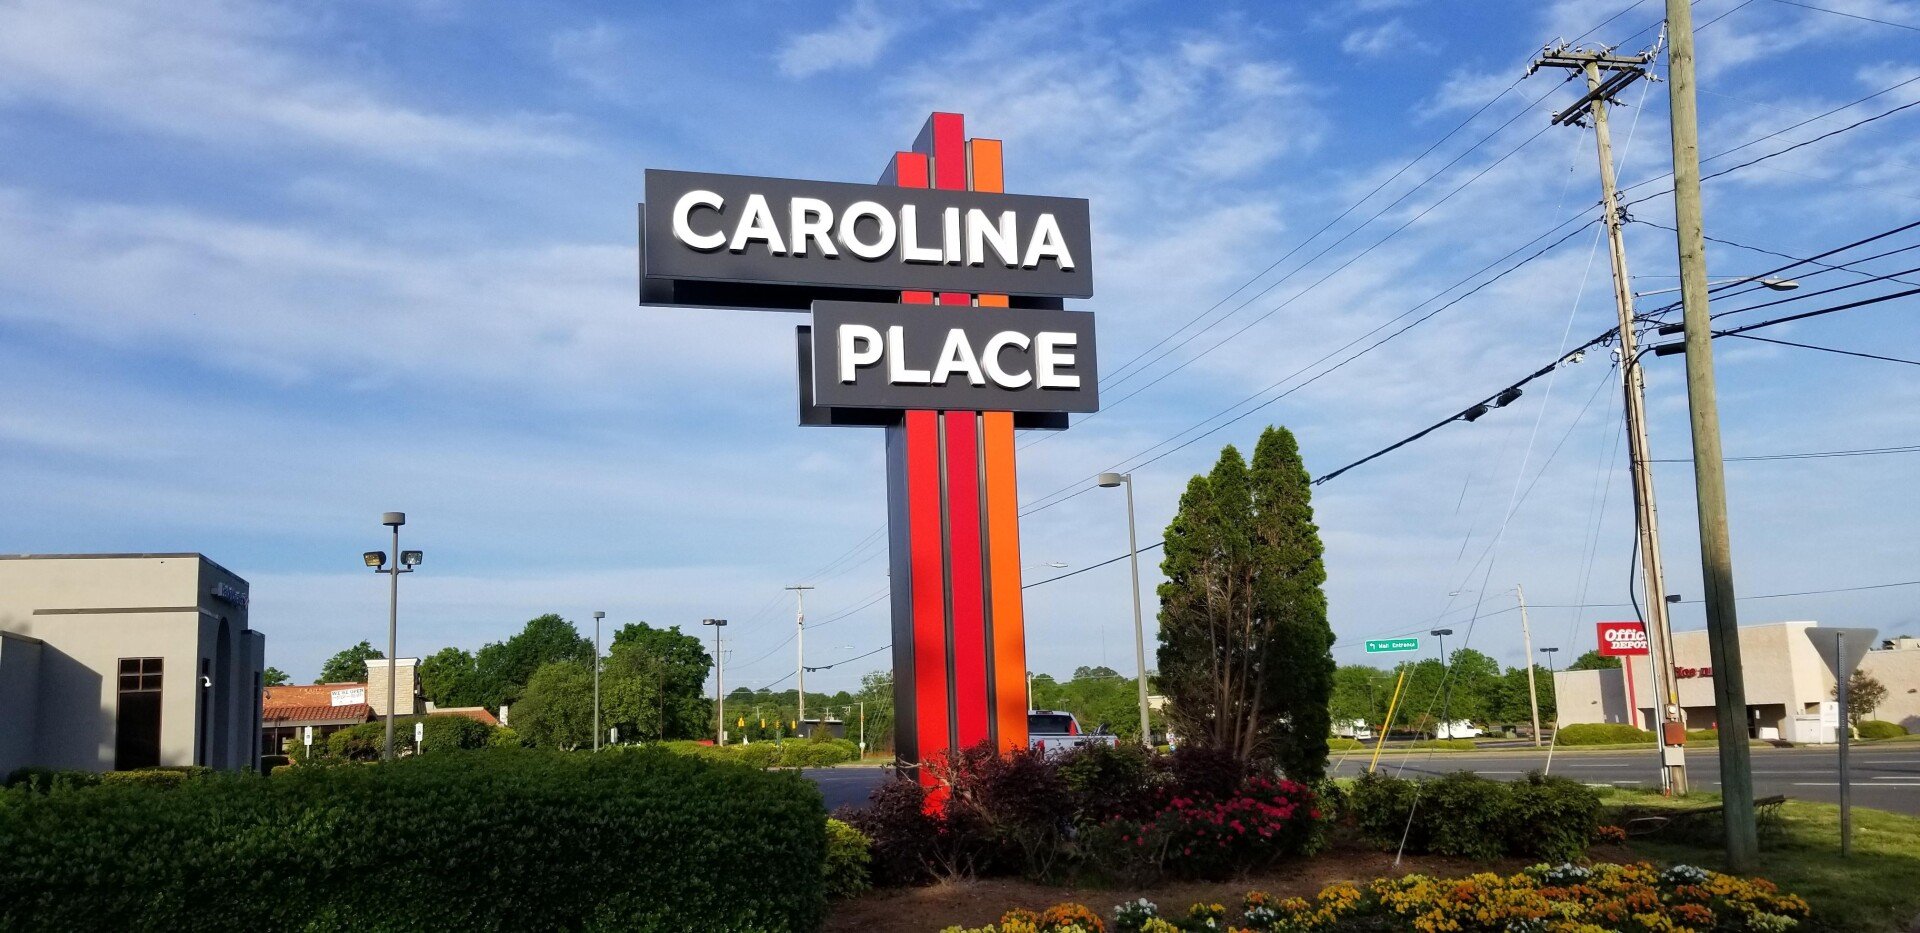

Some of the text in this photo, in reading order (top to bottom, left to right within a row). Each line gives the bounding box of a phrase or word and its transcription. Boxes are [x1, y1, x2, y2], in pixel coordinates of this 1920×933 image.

[672, 190, 1075, 271] CAROLINA
[838, 323, 1080, 389] PLACE
[1604, 628, 1647, 642] Offic
[1610, 641, 1648, 650] DEPOT
